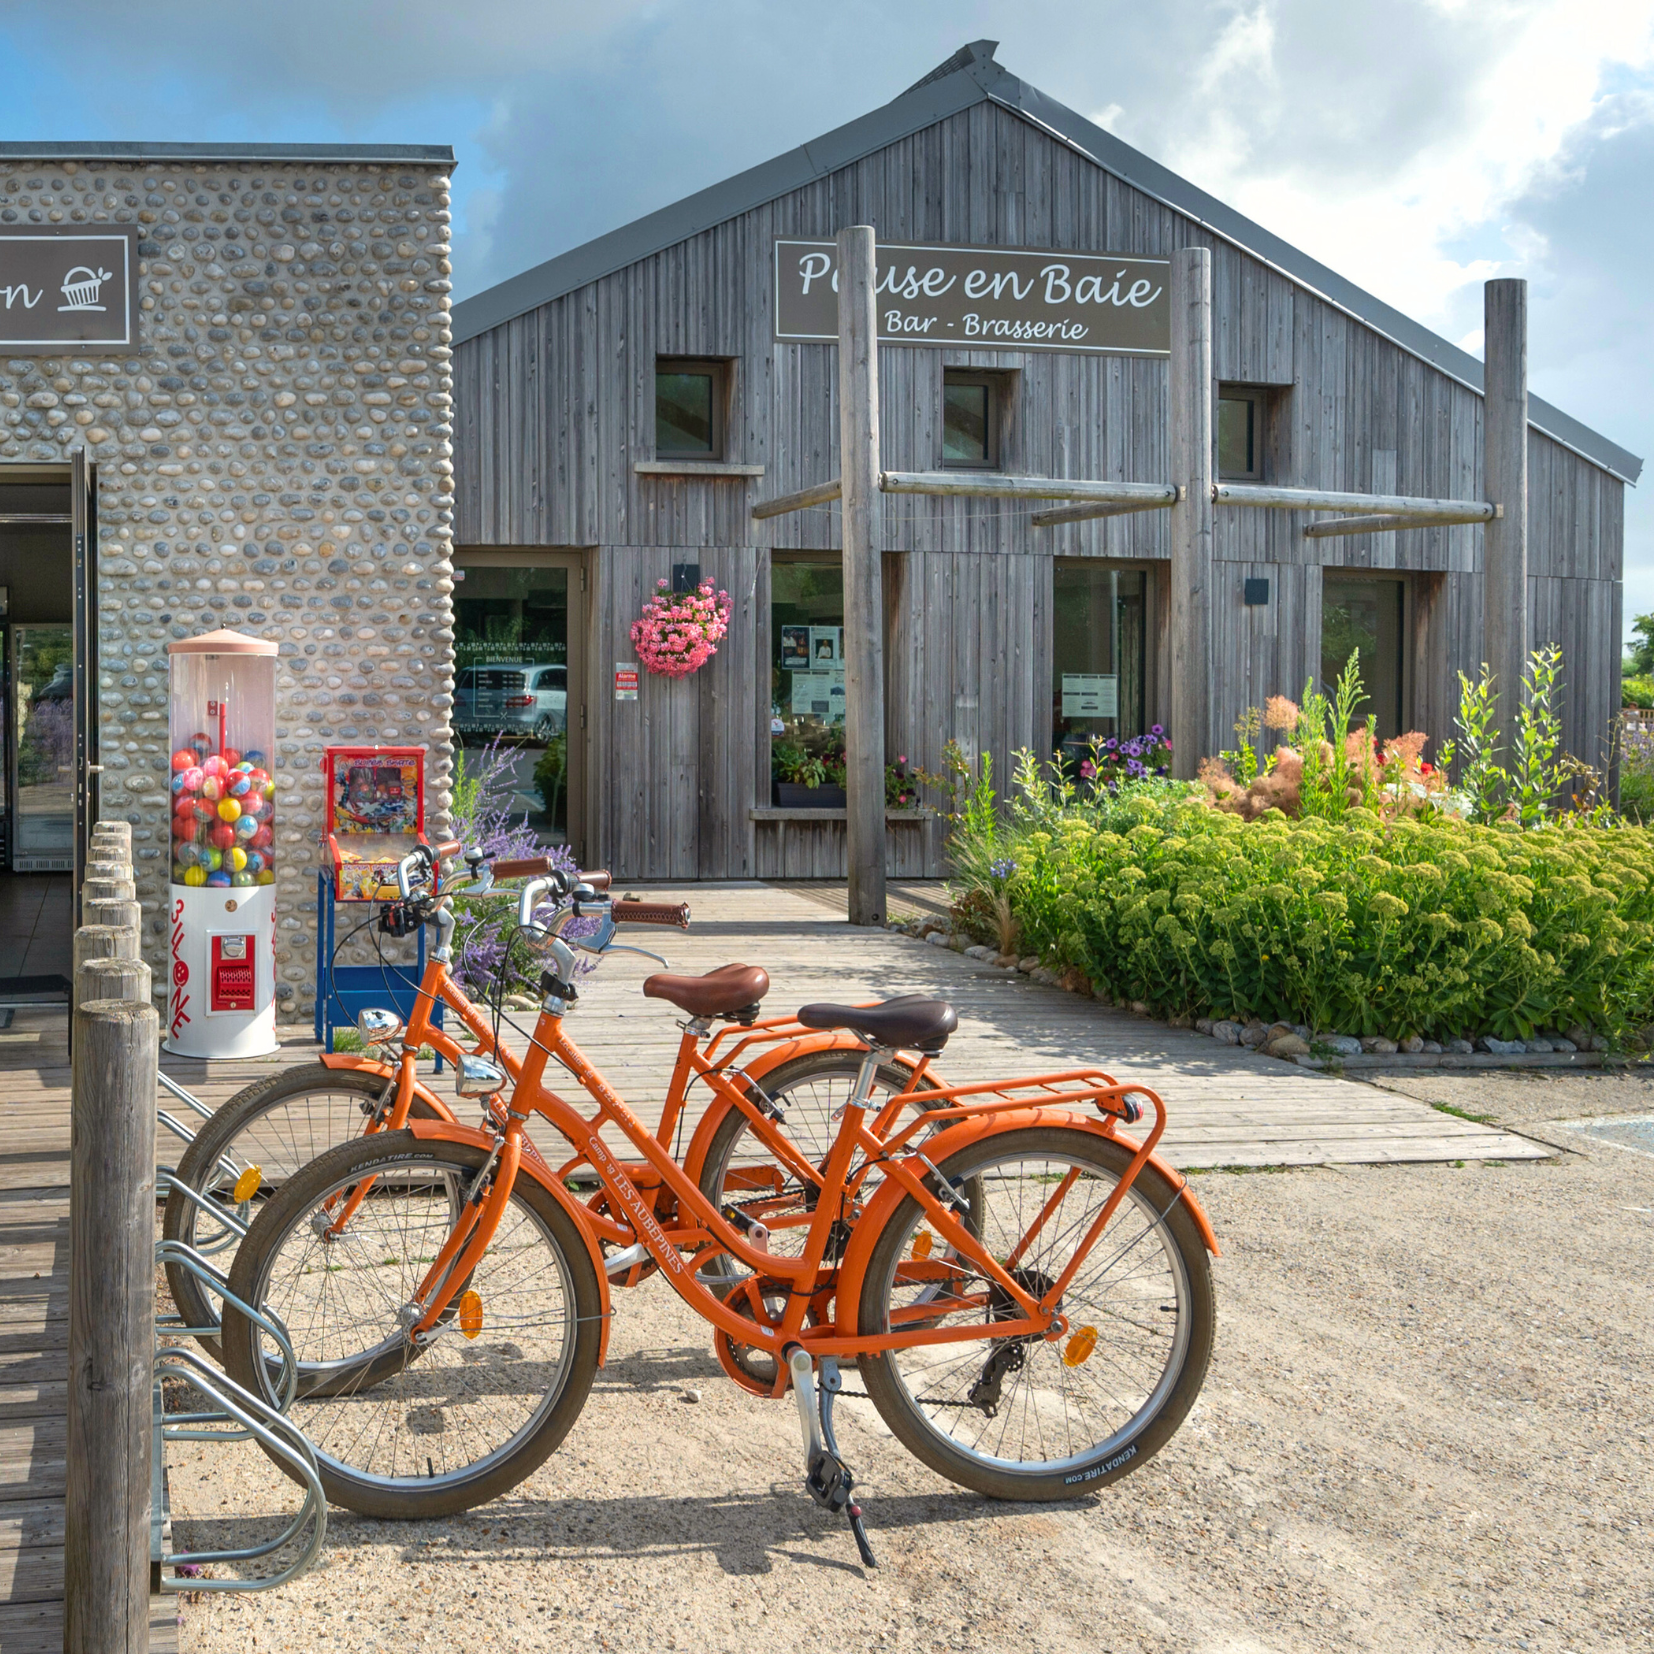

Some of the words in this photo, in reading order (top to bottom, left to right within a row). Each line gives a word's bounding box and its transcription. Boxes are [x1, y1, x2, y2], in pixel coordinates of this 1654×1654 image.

[799, 253, 957, 299] Puse
[964, 269, 1035, 300] en
[1040, 264, 1162, 307] Baie
[884, 310, 937, 333] Bar
[962, 313, 1089, 340] Brasserie
[486, 656, 523, 664] BIENVENUE
[350, 1153, 434, 1173] KENDATIRE.COM
[613, 1172, 635, 1200] LES
[1065, 1445, 1137, 1484] KENDATIRE.COM
